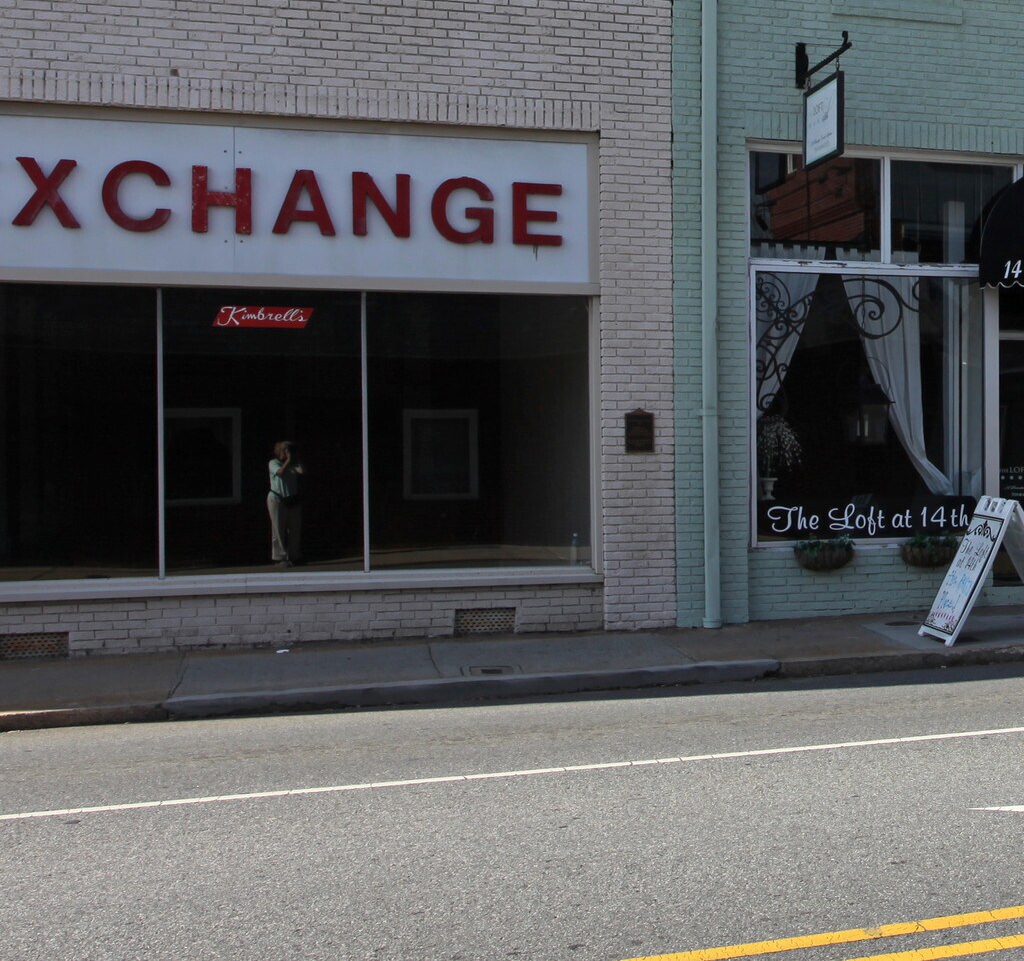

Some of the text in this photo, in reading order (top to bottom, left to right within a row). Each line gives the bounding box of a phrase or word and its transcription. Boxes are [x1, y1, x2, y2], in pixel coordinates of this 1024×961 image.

[11, 155, 564, 247] XCHANGE
[1004, 259, 1022, 279] 14
[217, 306, 307, 326] Kimbrell's
[766, 503, 969, 536] The Loft at 14th
